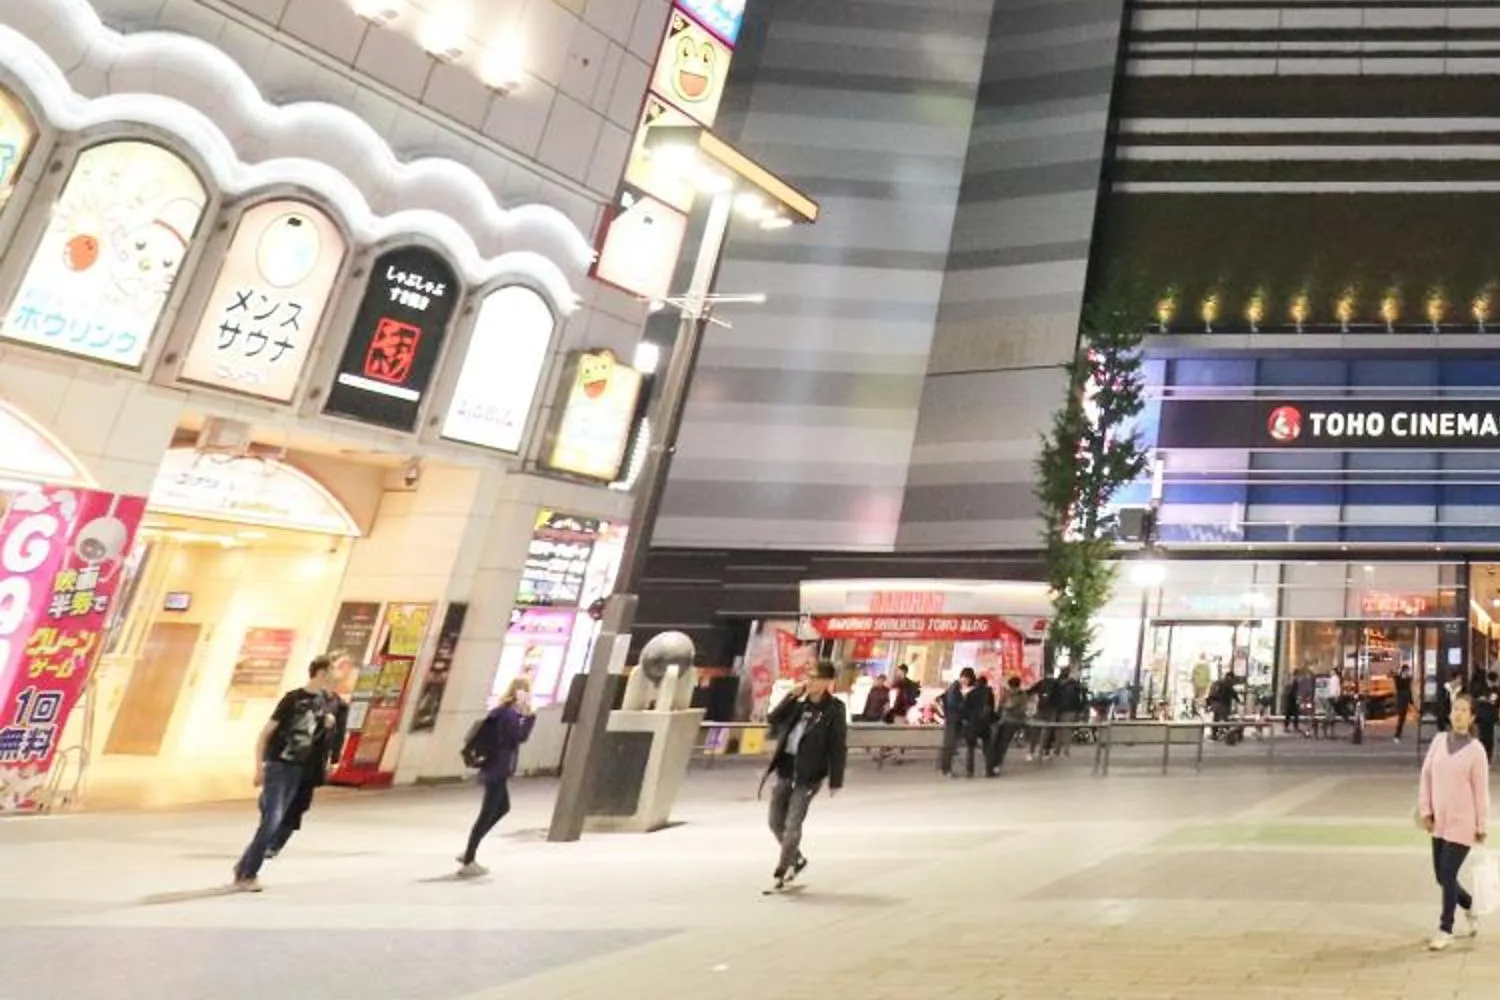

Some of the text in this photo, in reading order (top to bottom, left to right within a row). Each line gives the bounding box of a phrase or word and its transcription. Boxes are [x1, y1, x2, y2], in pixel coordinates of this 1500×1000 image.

[217, 319, 295, 362] サウナ
[1309, 412, 1385, 437] TOHO
[17, 687, 62, 724] 1回
